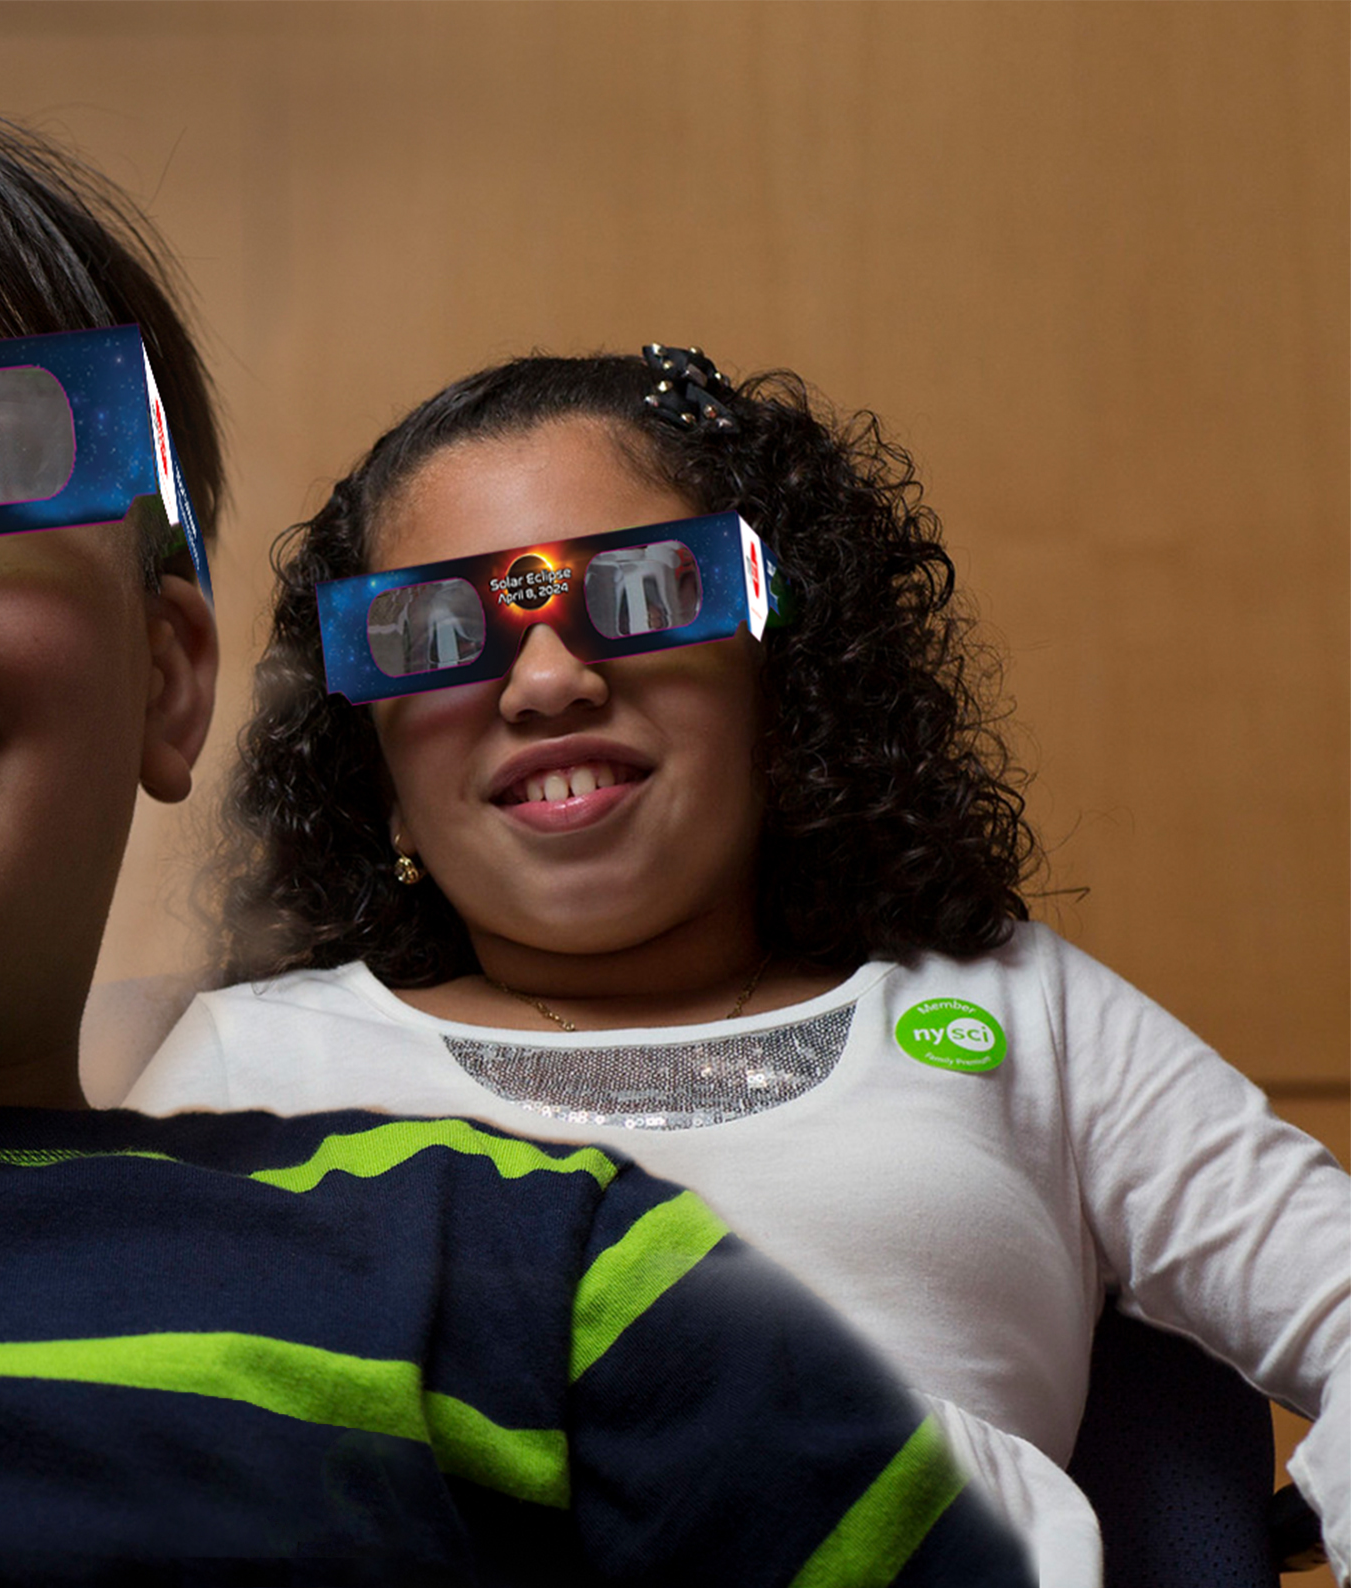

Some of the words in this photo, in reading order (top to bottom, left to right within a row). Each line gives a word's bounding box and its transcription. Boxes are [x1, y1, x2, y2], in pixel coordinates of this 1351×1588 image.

[490, 575, 523, 591] Solar
[526, 568, 571, 585] Eclipse
[498, 589, 524, 605] April
[525, 588, 537, 599] 8,
[538, 582, 569, 597] 2024
[917, 1000, 976, 1015] Member
